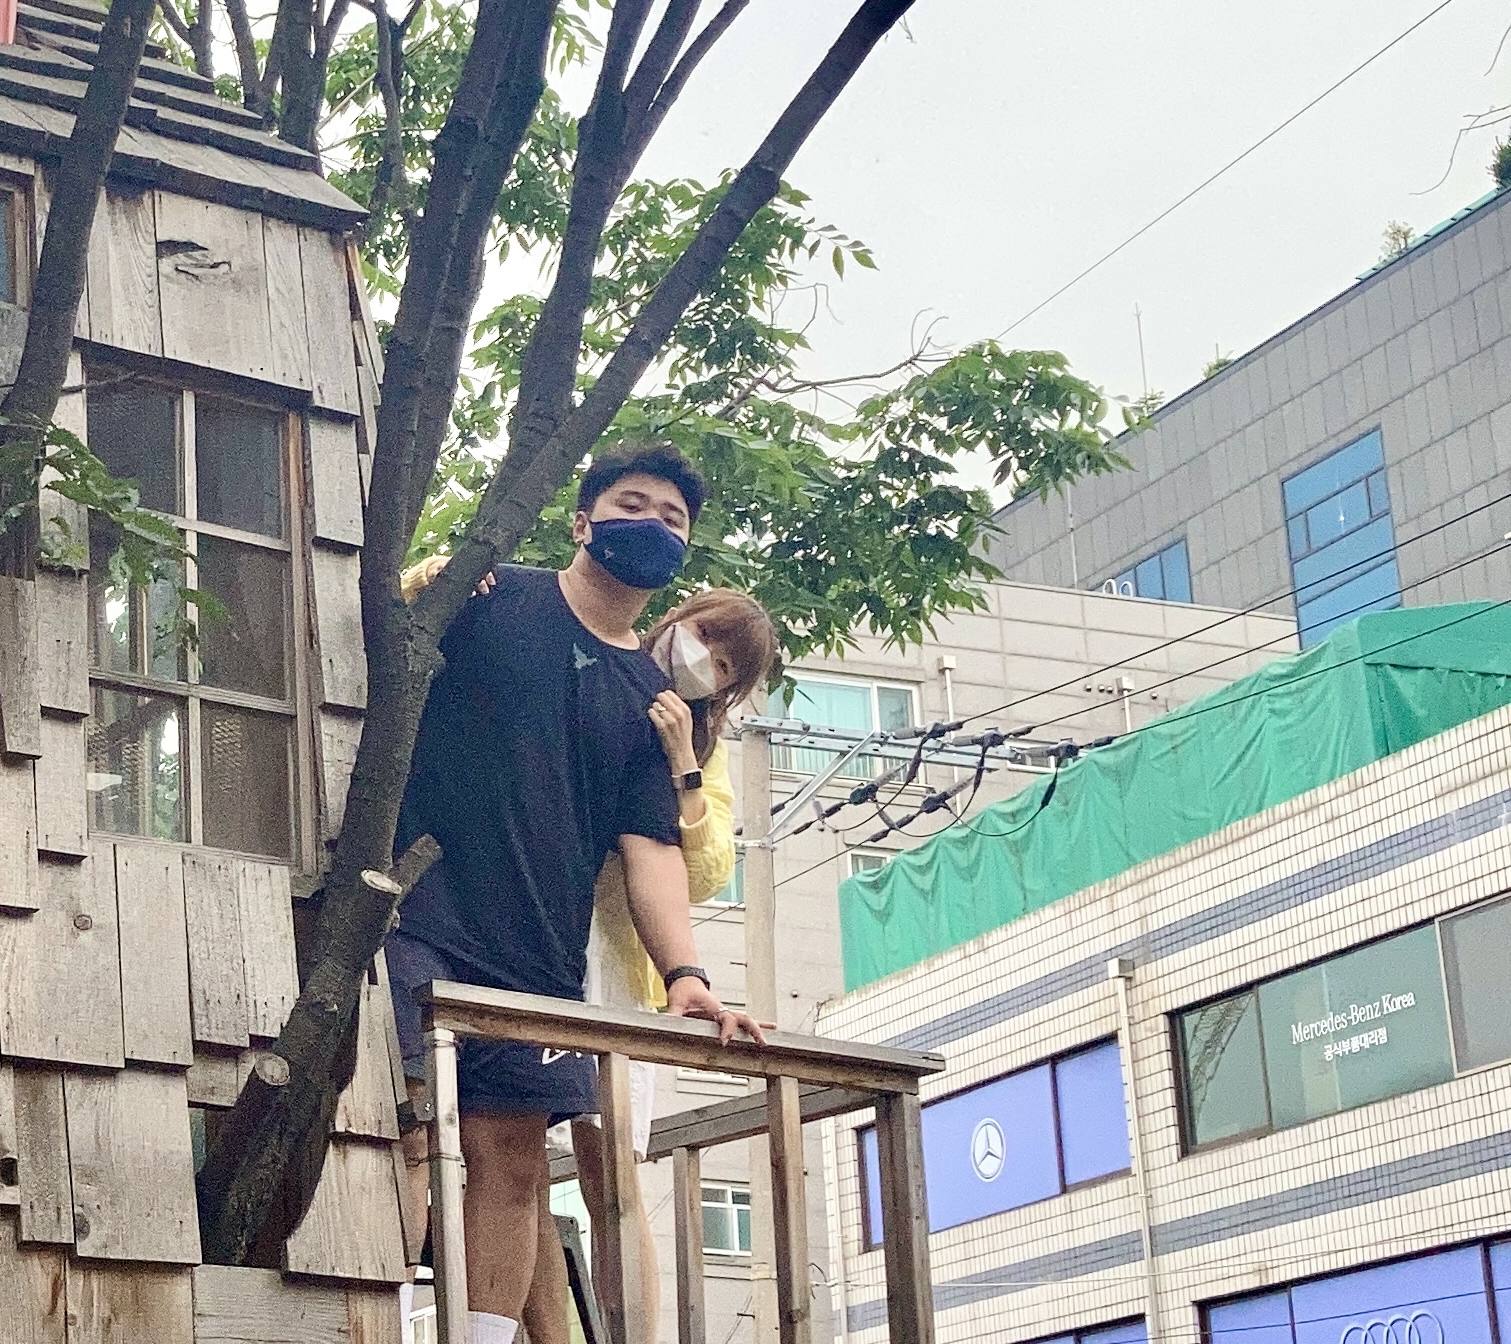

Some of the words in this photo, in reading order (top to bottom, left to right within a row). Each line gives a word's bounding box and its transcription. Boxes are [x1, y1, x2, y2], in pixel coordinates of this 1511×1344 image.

[1291, 1001, 1381, 1044] Mercedes-Benz
[1381, 992, 1416, 1014] Korea
[1324, 1027, 1388, 1061] 공식부품대리점
